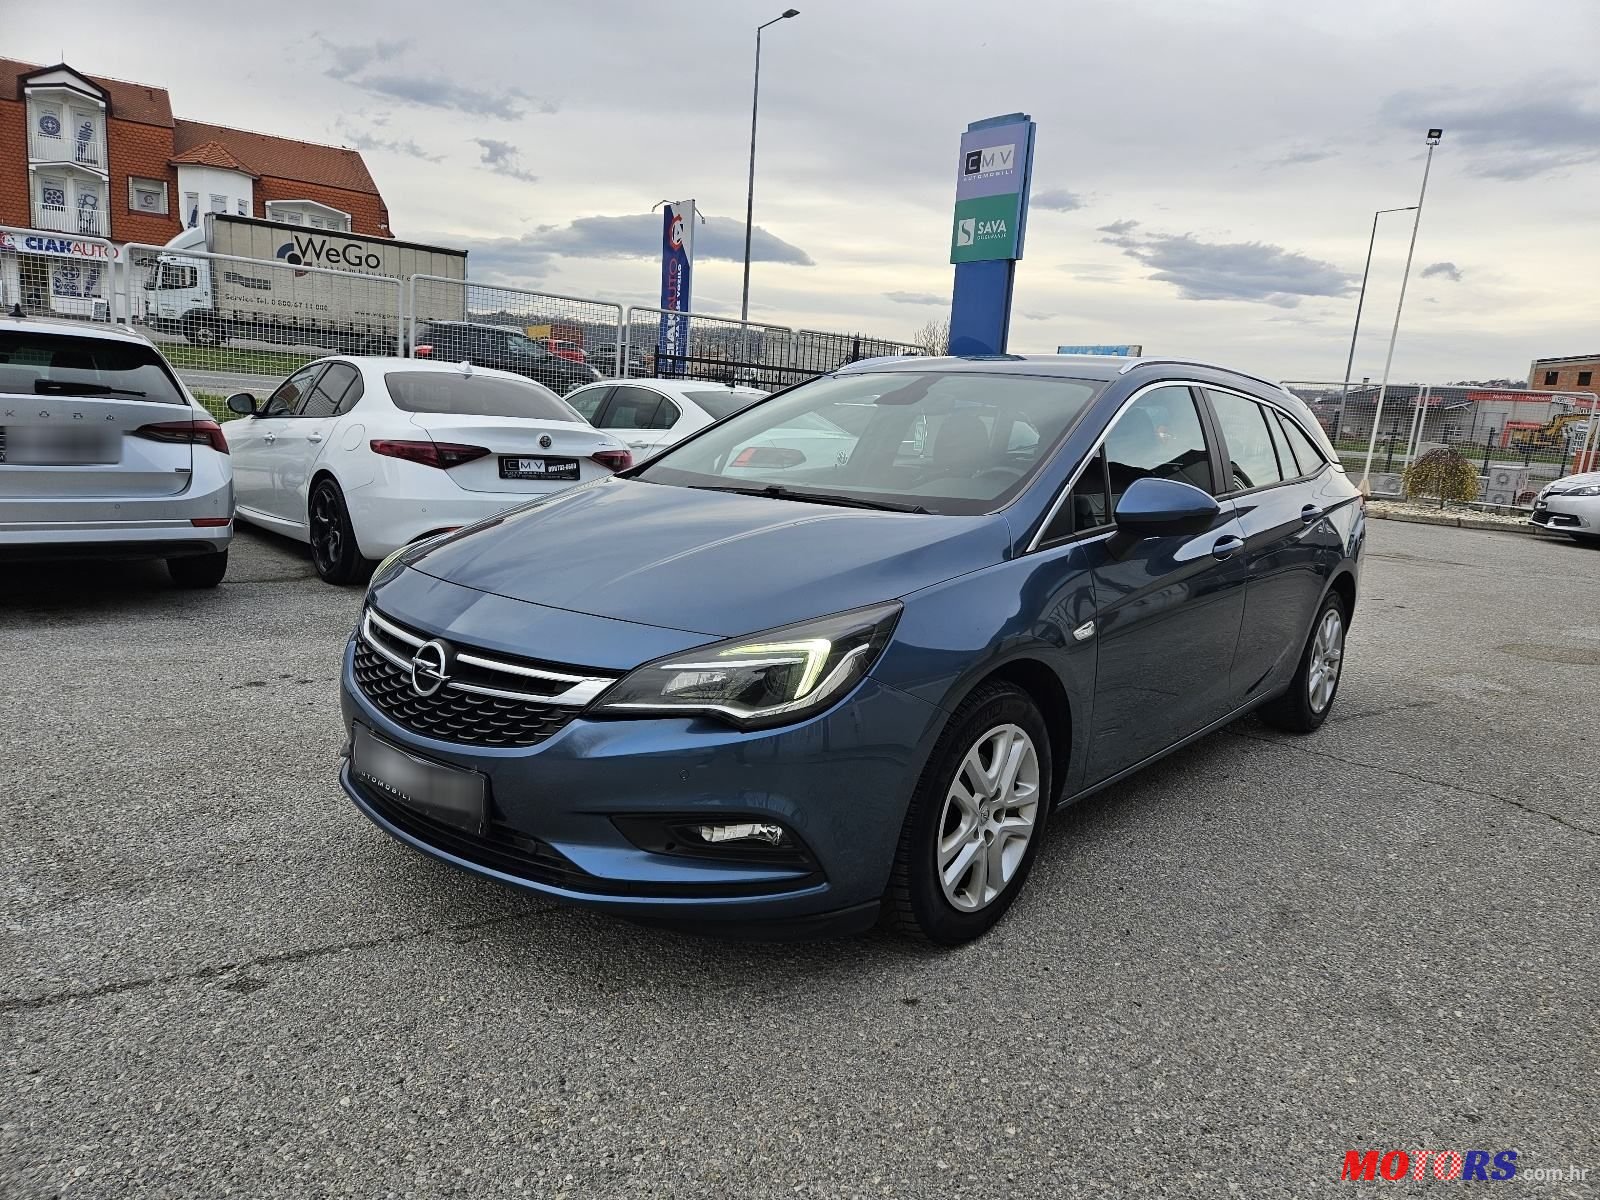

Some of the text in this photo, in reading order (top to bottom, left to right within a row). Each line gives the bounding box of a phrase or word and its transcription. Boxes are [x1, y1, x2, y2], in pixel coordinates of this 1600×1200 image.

[968, 150, 1012, 169] CMV
[978, 220, 1007, 234] SAVA
[294, 235, 381, 269] WeGo
[361, 771, 411, 802] UTOMOBILI
